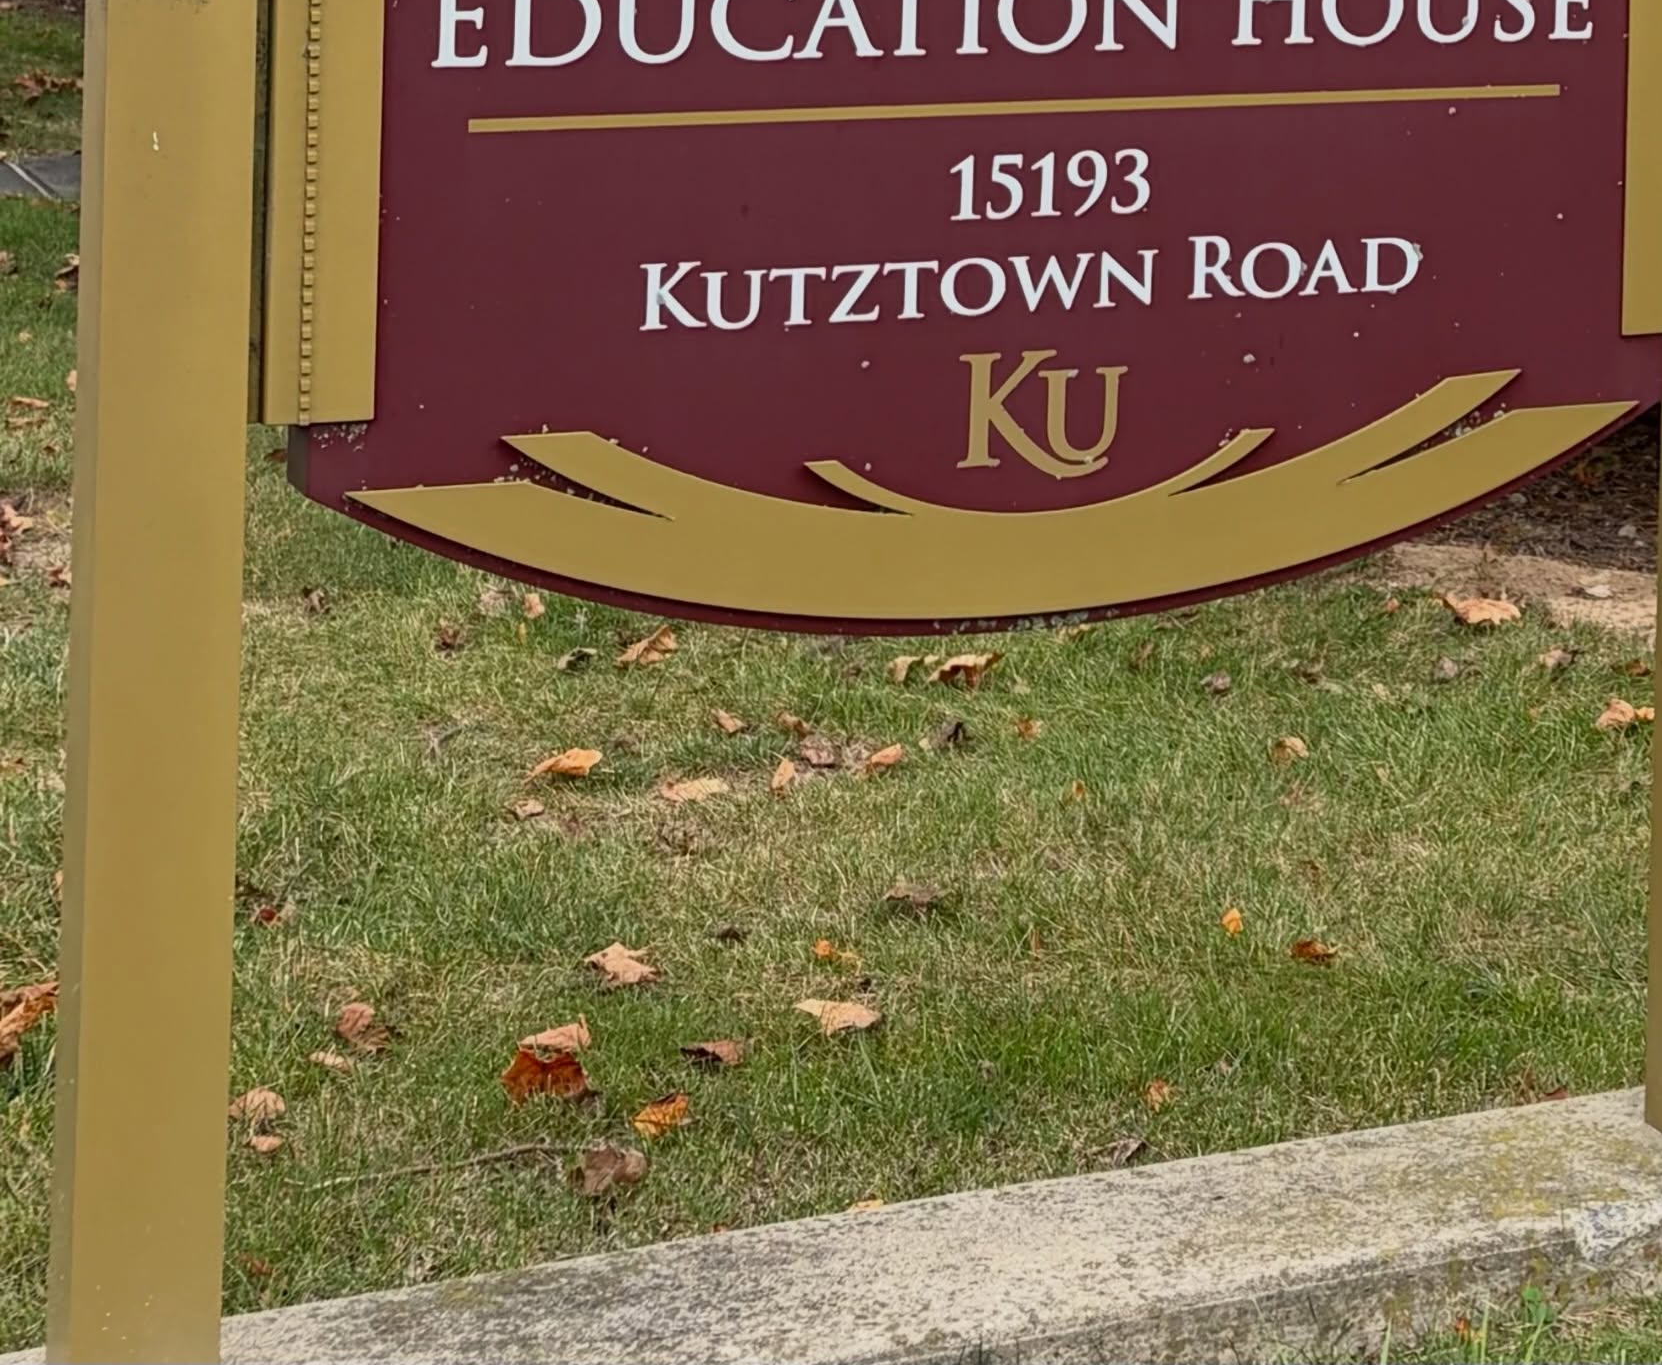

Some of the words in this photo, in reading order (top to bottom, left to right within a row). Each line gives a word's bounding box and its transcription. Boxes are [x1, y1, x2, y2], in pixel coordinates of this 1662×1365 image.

[949, 148, 1151, 222] 15193
[639, 249, 1159, 331] KUTZTOWN
[1188, 235, 1421, 299] ROAD
[957, 349, 1128, 479] KU
